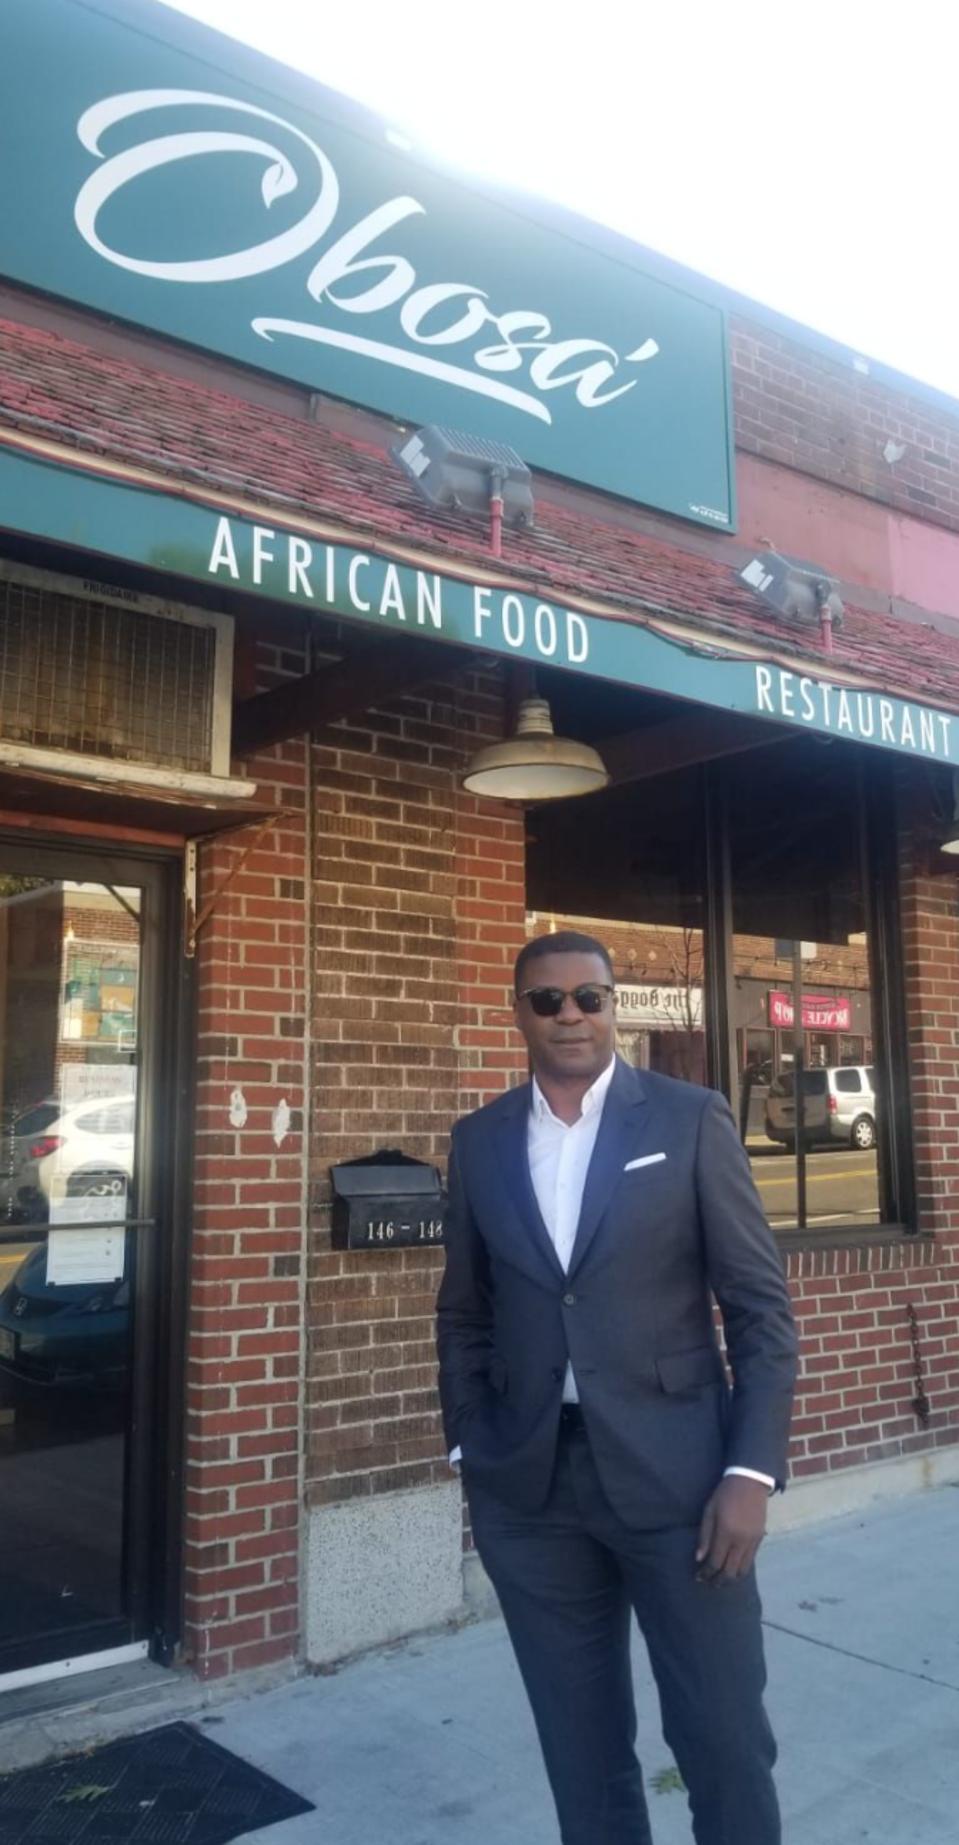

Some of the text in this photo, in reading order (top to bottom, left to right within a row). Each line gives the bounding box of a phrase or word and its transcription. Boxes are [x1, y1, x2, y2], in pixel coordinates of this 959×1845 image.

[75, 89, 659, 408] Obosá
[208, 516, 590, 663] AFRICAN FOOD
[755, 664, 952, 758] RESTAURANT
[367, 1221, 395, 1240] 146
[419, 1220, 443, 1239] 148
